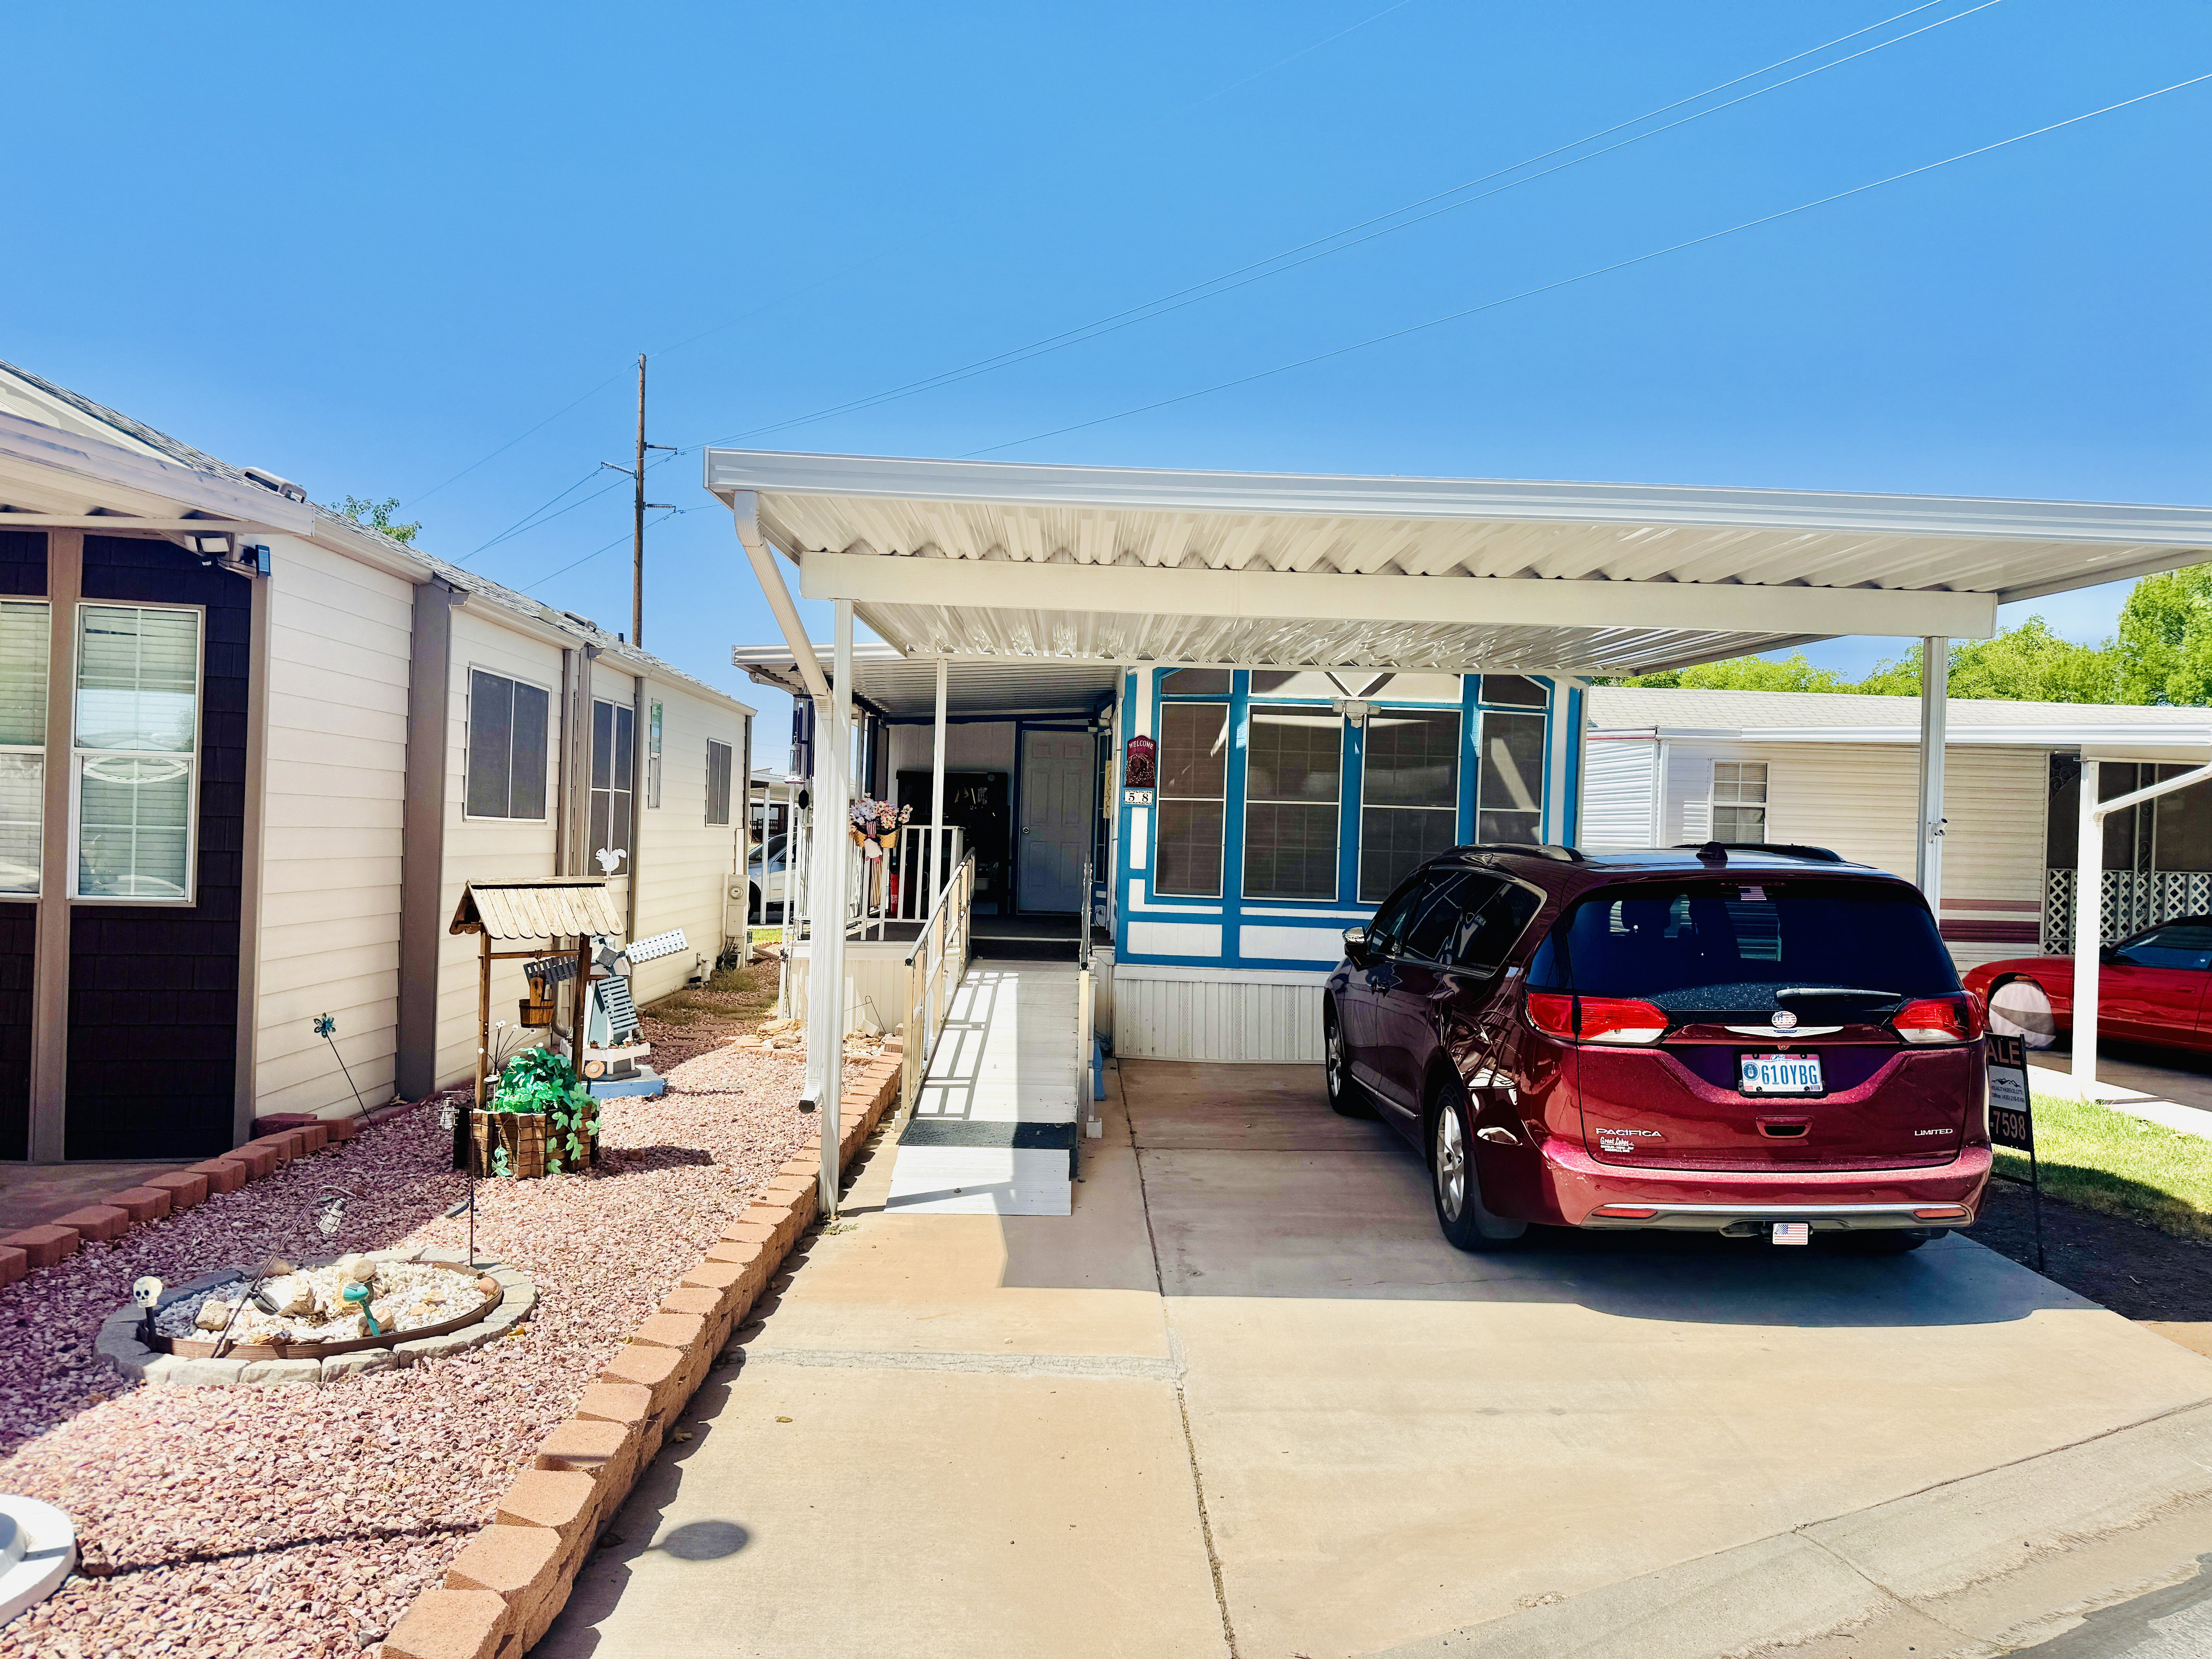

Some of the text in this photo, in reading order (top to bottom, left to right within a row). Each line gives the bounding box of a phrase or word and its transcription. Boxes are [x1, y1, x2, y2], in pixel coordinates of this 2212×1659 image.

[1129, 740, 1154, 750] WELCOME
[1987, 1038, 2021, 1065] ALE
[1762, 1065, 1818, 1085] 610YBG
[1595, 1128, 1662, 1137] PACIFICA
[1600, 1136, 1614, 1145] Great
